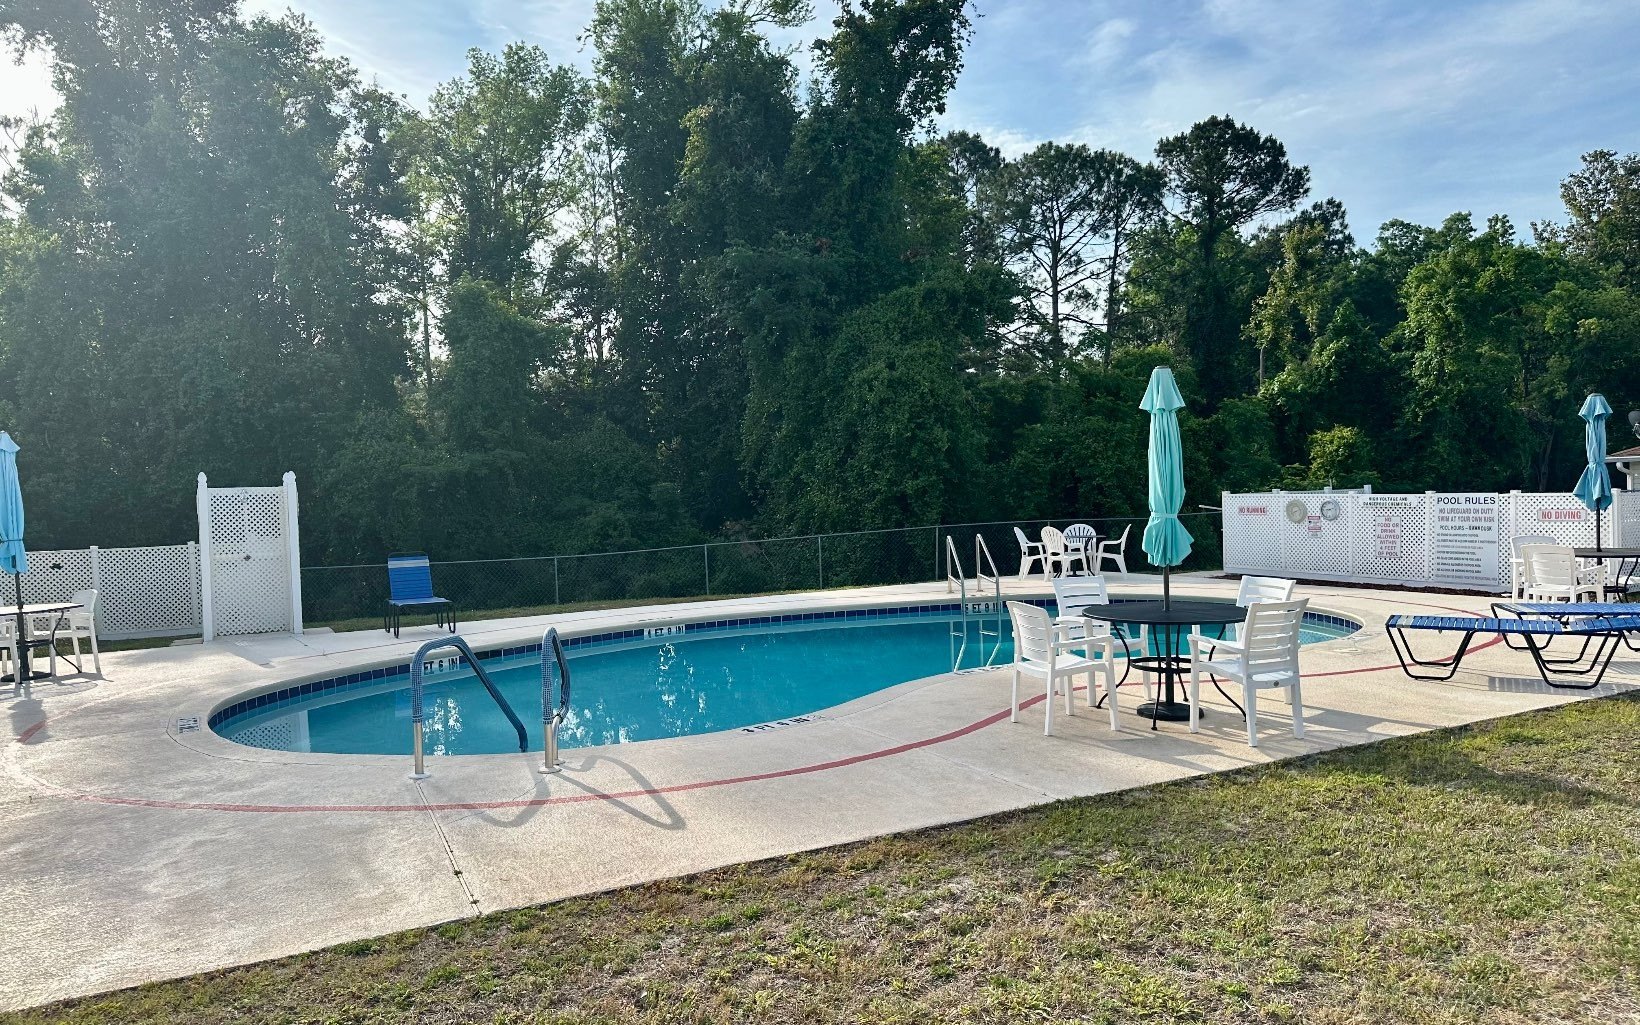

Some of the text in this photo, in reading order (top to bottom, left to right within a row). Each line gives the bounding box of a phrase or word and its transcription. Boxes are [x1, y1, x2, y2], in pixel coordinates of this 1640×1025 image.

[1437, 496, 1496, 505] POOL RULES
[1446, 507, 1472, 515] LIFEGUARD
[1480, 507, 1494, 515] DUTY
[1541, 511, 1582, 520] NO DIVING
